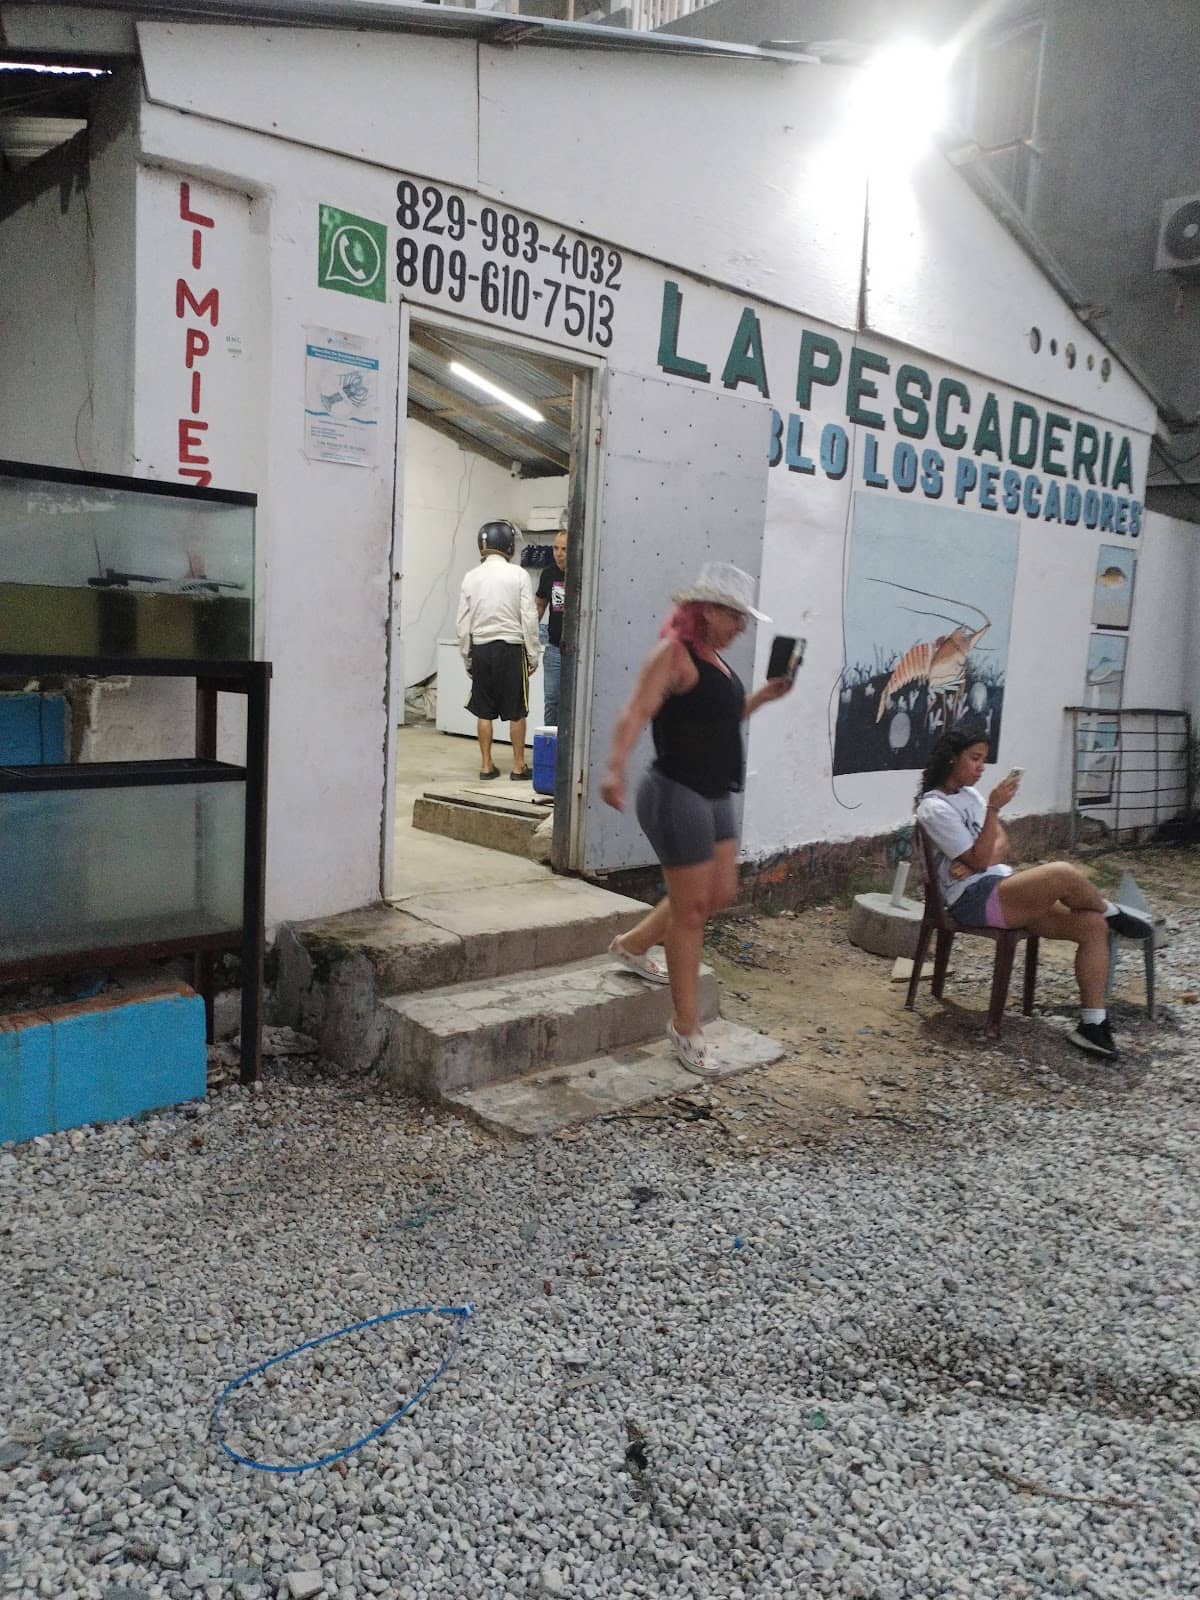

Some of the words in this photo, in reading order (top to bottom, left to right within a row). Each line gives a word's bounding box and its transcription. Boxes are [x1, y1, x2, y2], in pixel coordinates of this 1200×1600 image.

[397, 180, 623, 291] 829-983-4032
[396, 237, 615, 348] 809-610-7513
[657, 280, 770, 399] LA
[795, 329, 1134, 493] PESCADERIA
[863, 433, 945, 499] LOS
[955, 457, 1144, 537] PESCADORES
